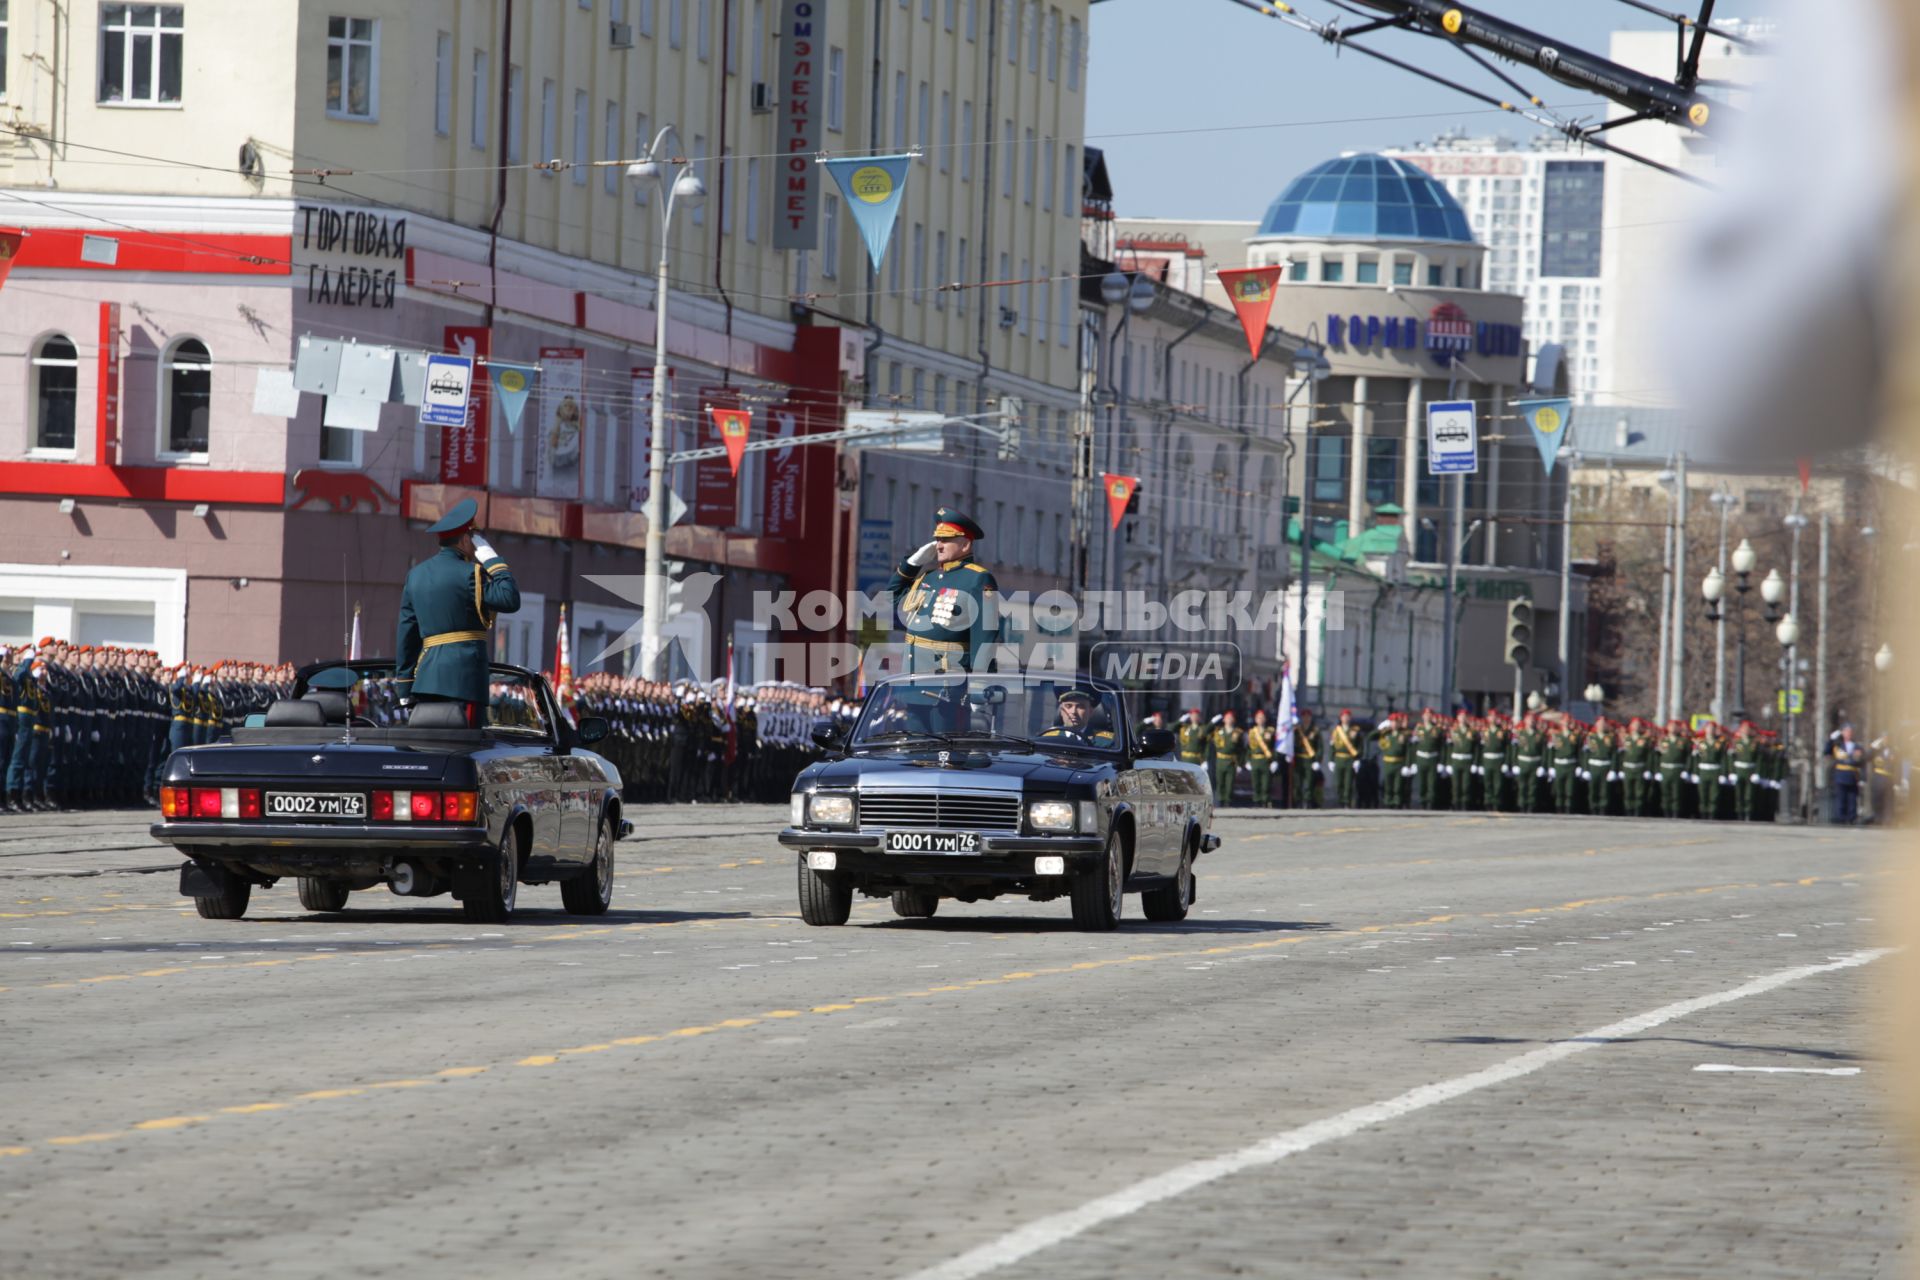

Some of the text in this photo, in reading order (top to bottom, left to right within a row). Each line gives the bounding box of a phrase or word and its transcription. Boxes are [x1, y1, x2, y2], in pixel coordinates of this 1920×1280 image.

[299, 205, 406, 259] ТОРГОВАЯ
[308, 264, 396, 308] ГАЛЕРЕЯ
[274, 796, 315, 813] 0002
[342, 797, 360, 809] 76
[892, 833, 932, 850] 0001
[959, 834, 975, 847] 76
